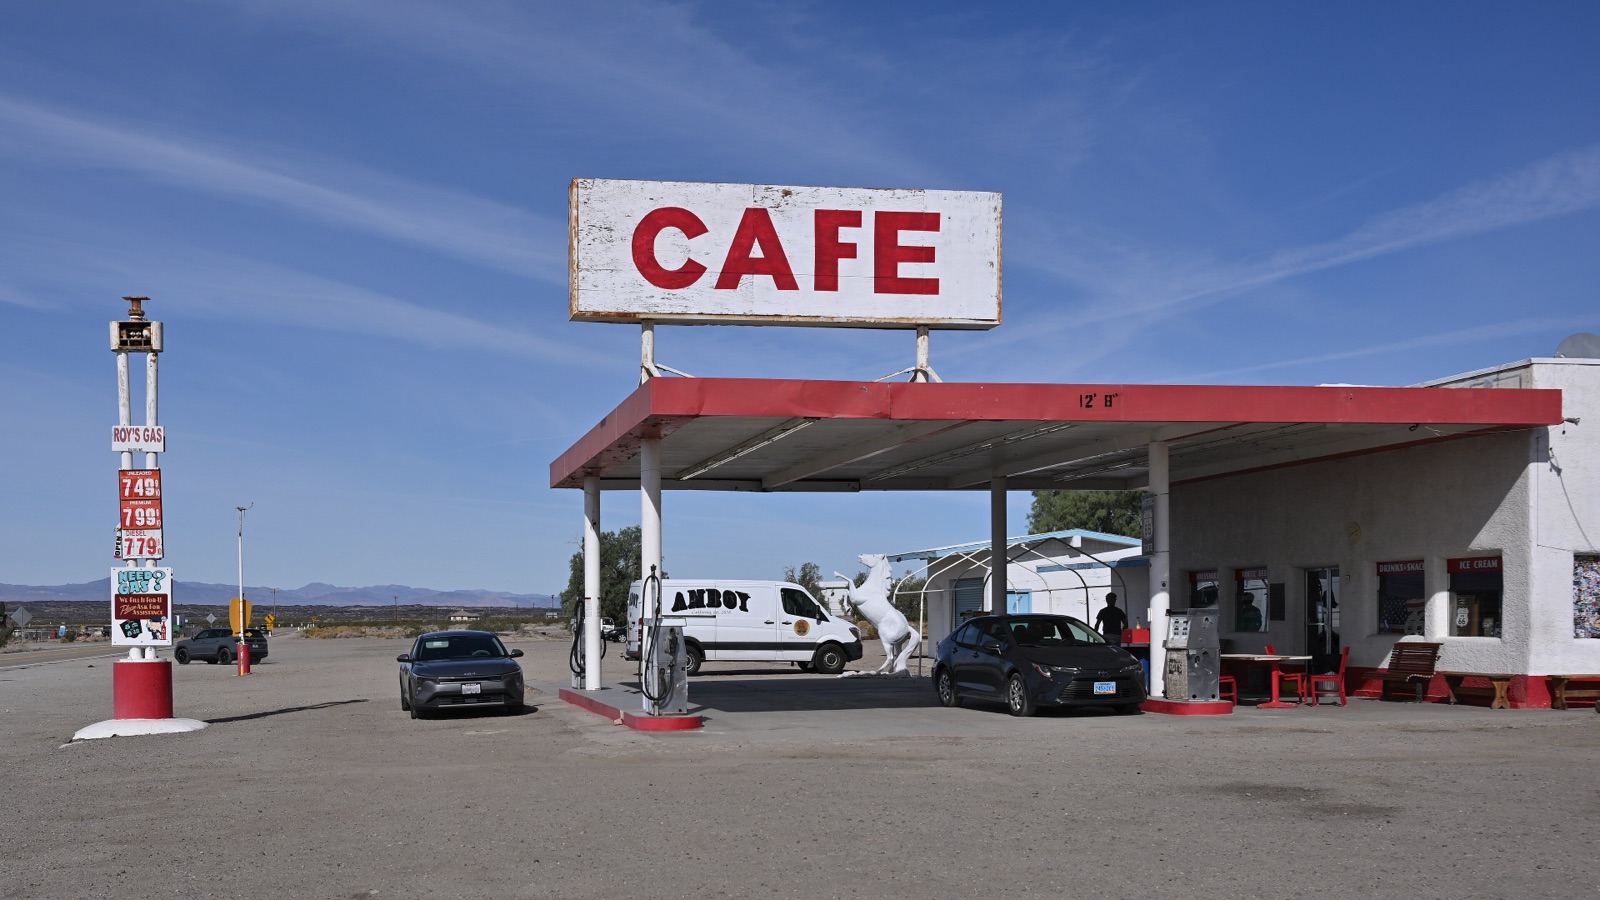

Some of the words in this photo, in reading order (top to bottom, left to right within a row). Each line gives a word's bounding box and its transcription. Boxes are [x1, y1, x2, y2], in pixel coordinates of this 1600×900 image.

[631, 206, 941, 296] CAFE
[113, 427, 141, 443] ROY'S
[143, 427, 163, 443] GAS
[122, 478, 155, 497] 749
[122, 507, 156, 527] 799
[124, 537, 157, 555] 779
[1460, 561, 1470, 570] ICE
[1473, 559, 1498, 569] CREAM
[118, 571, 152, 584] NEED
[118, 581, 149, 595] GAS
[671, 588, 751, 612] AMBOY
